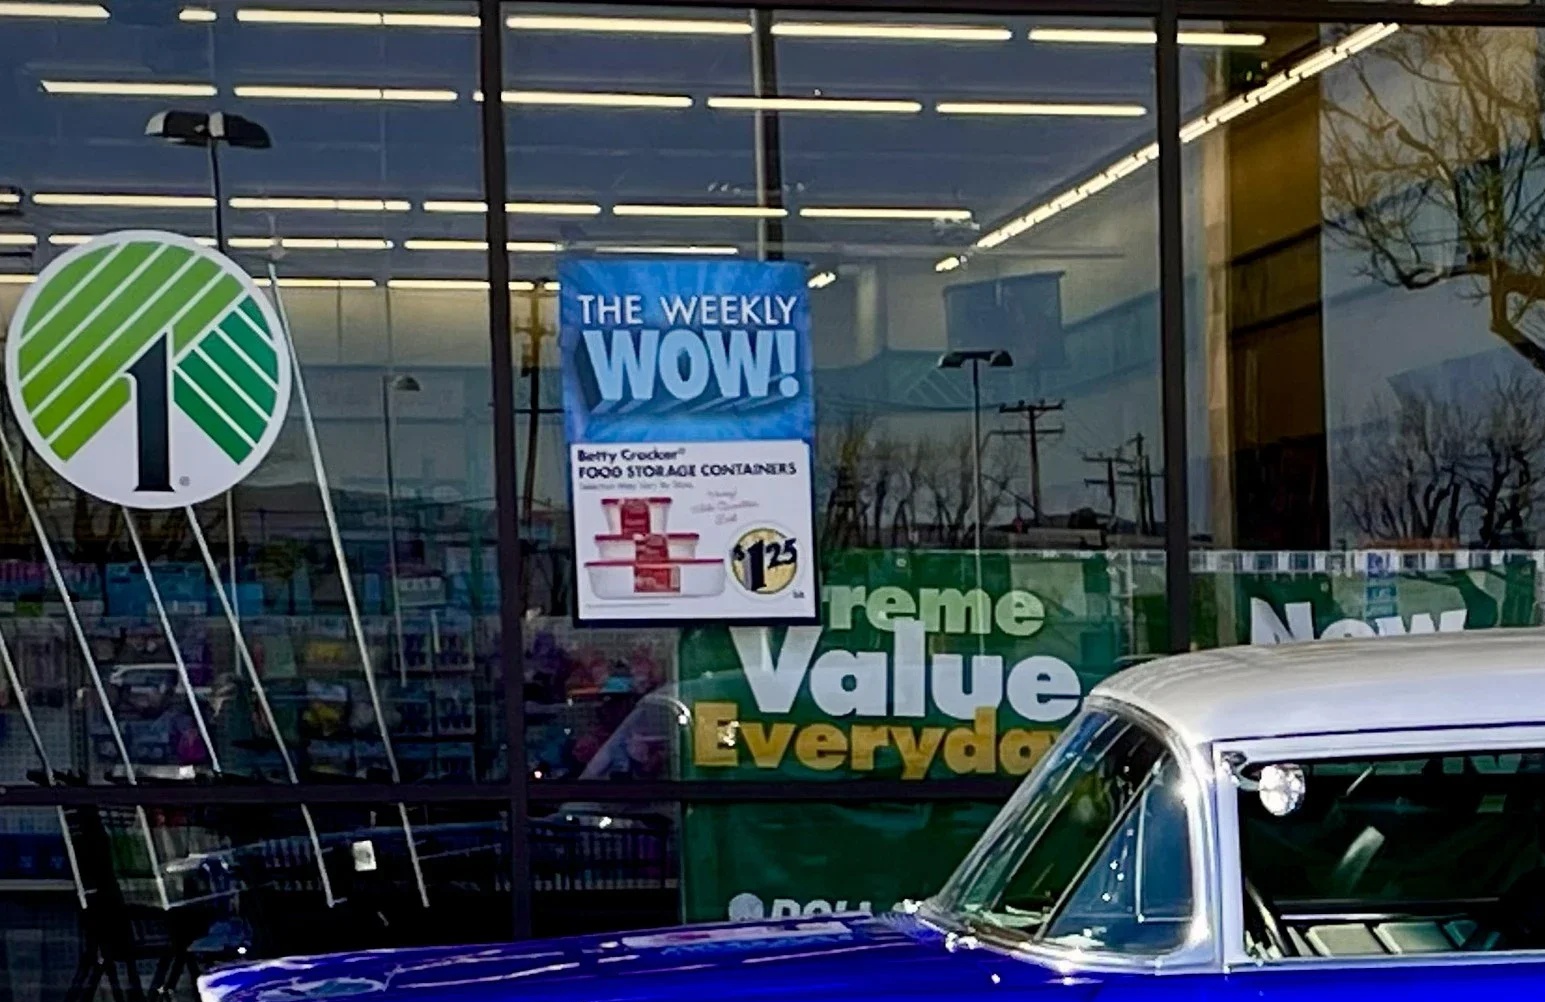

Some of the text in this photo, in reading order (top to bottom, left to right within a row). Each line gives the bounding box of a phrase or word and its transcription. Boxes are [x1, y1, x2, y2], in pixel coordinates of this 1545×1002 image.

[577, 294, 797, 325] THE WEEKLY
[583, 329, 800, 402] WOW!
[577, 449, 617, 464] Betty
[578, 461, 797, 480] FOOD STORAGE CONTAINERS
[821, 584, 1046, 637] reme
[729, 620, 1082, 722] Value
[693, 701, 1063, 781] Everyda
